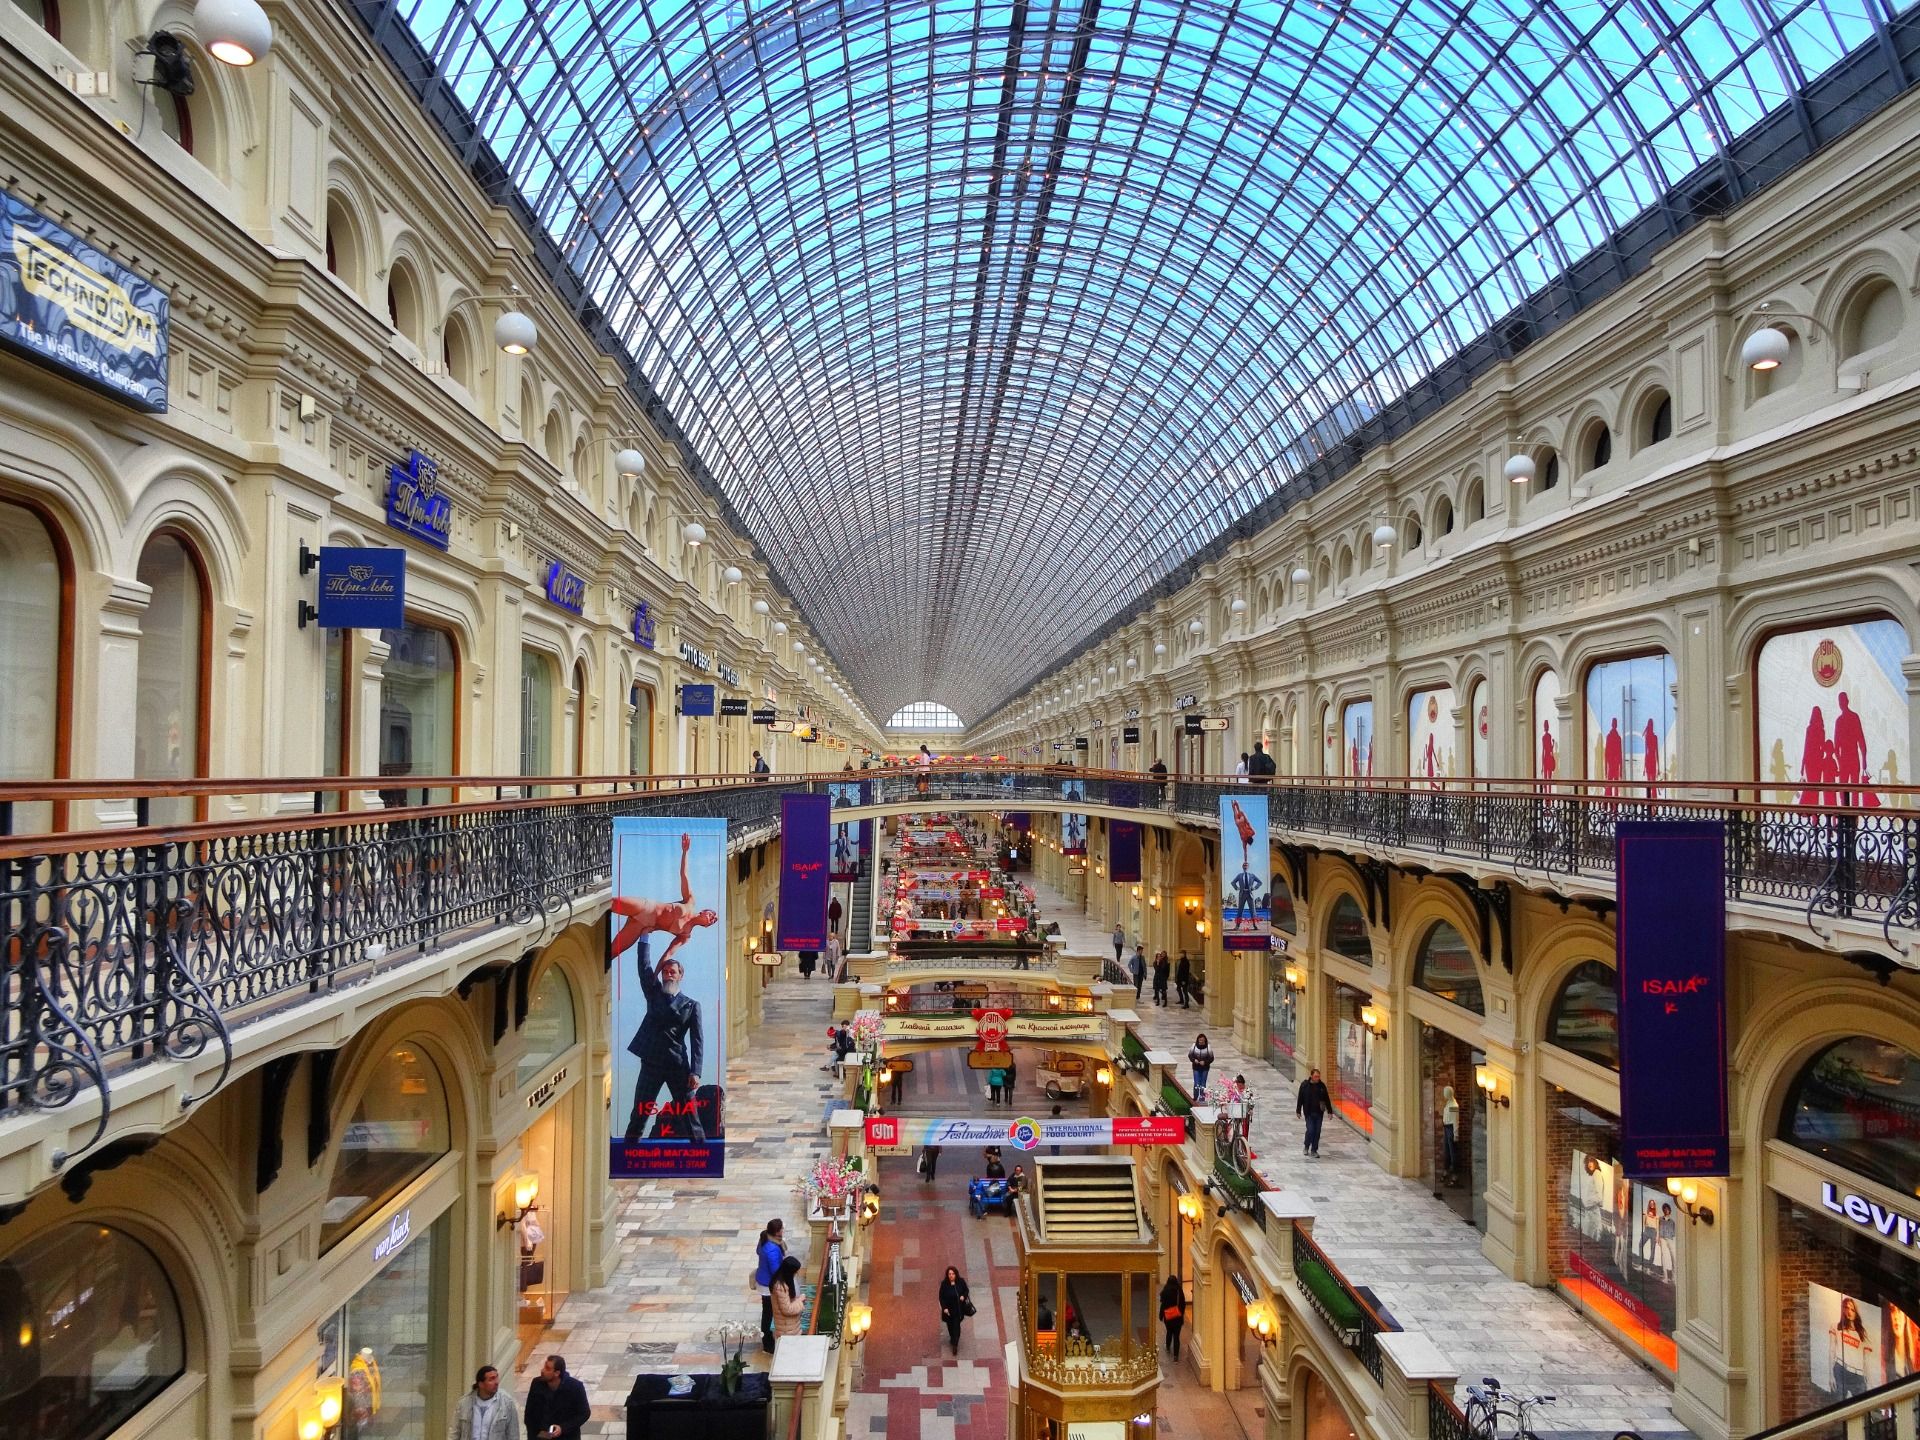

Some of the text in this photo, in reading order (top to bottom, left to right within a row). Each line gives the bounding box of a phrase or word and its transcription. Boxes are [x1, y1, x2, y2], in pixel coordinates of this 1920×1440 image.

[18, 322, 43, 346] The
[101, 362, 148, 398] Company
[326, 577, 360, 597] Три
[1642, 979, 1698, 994] ISAIA
[900, 1021, 931, 1031] Главный
[1028, 1022, 1059, 1032] Красной
[1060, 1023, 1090, 1031] площади
[638, 1099, 694, 1116] ISAIA
[625, 1147, 710, 1158] НОВЫЙ МАГАЗИН
[1822, 1181, 1920, 1247] Levi'
[1589, 1270, 1613, 1295] СКИДКИ
[1614, 1289, 1623, 1302] ДО
